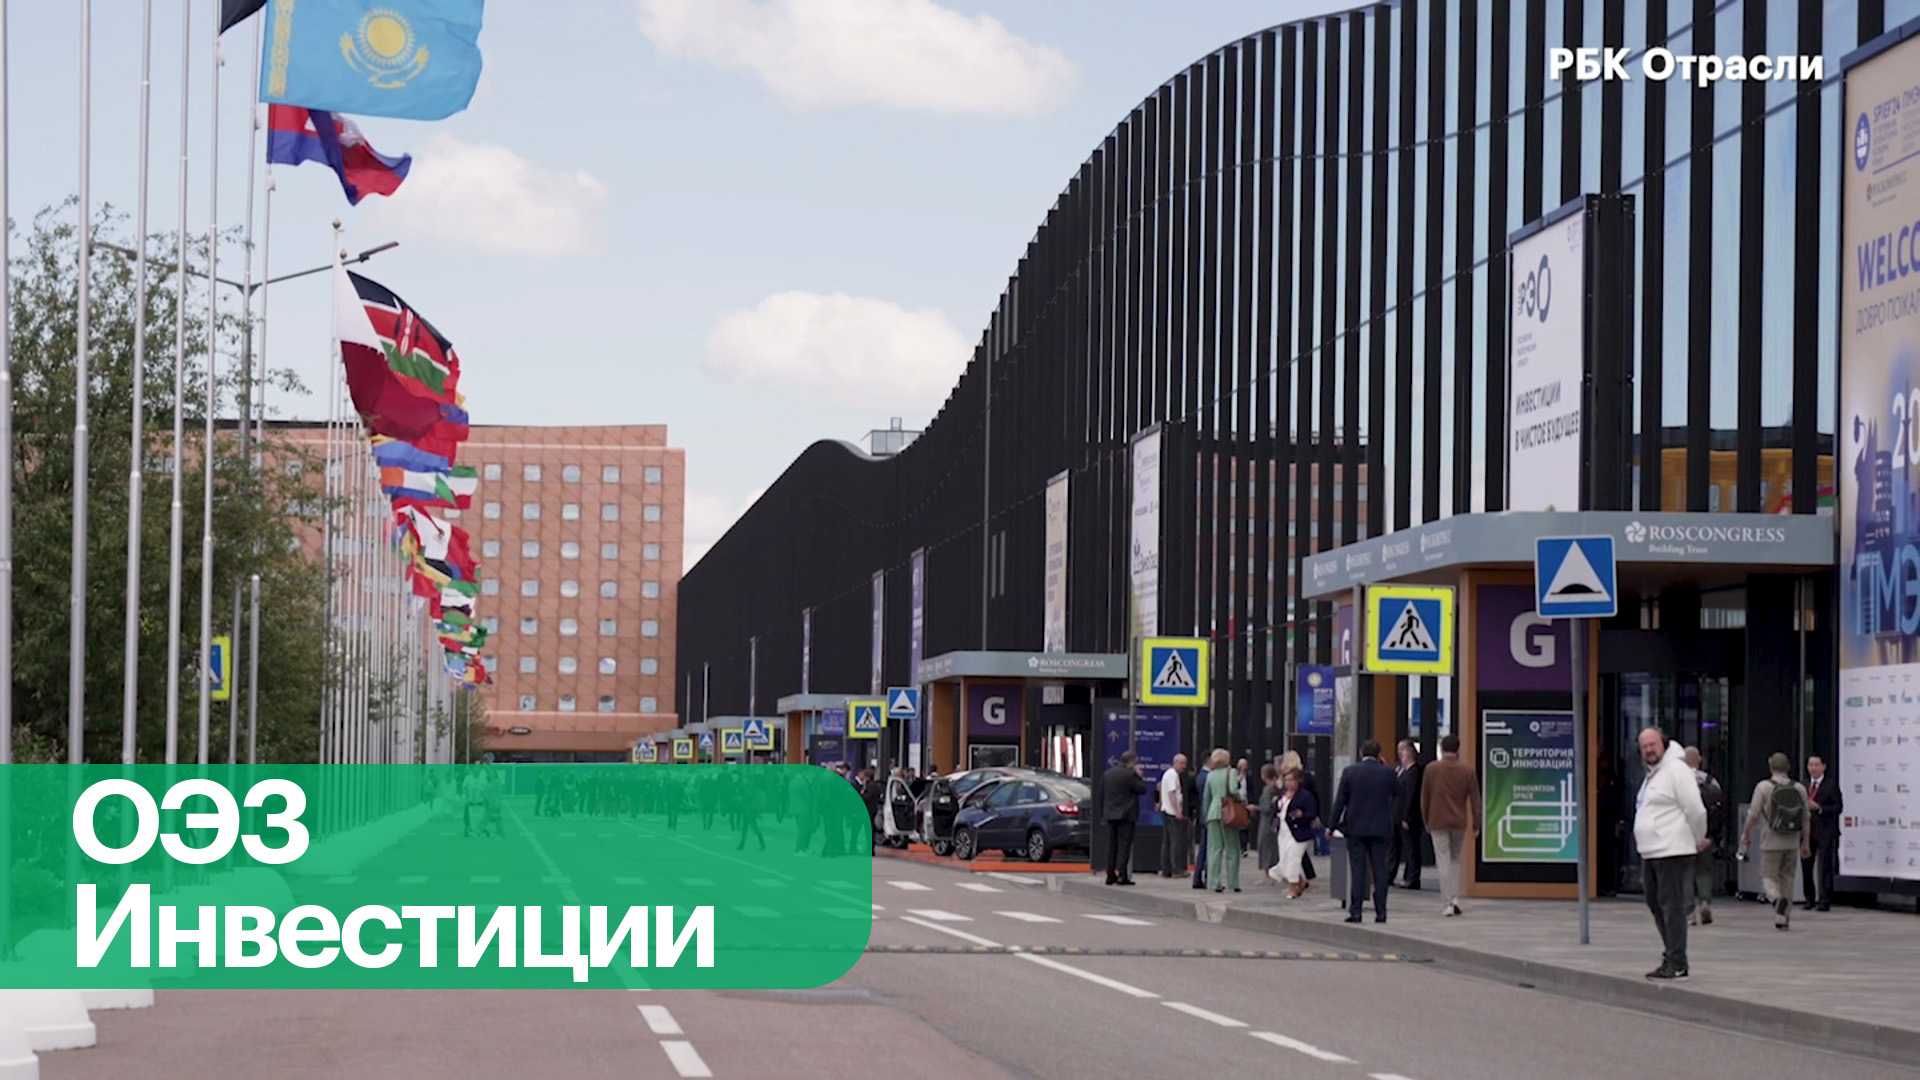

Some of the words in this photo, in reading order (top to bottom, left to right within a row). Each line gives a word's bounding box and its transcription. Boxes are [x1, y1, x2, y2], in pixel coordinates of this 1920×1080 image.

[1649, 525, 1786, 543] ROSCONGRESS
[1510, 610, 1556, 668] G
[982, 696, 1006, 725] G
[1512, 748, 1574, 758] ТЕРРИТОРИЯ
[1512, 757, 1573, 770] ИННОВАЦИЙ
